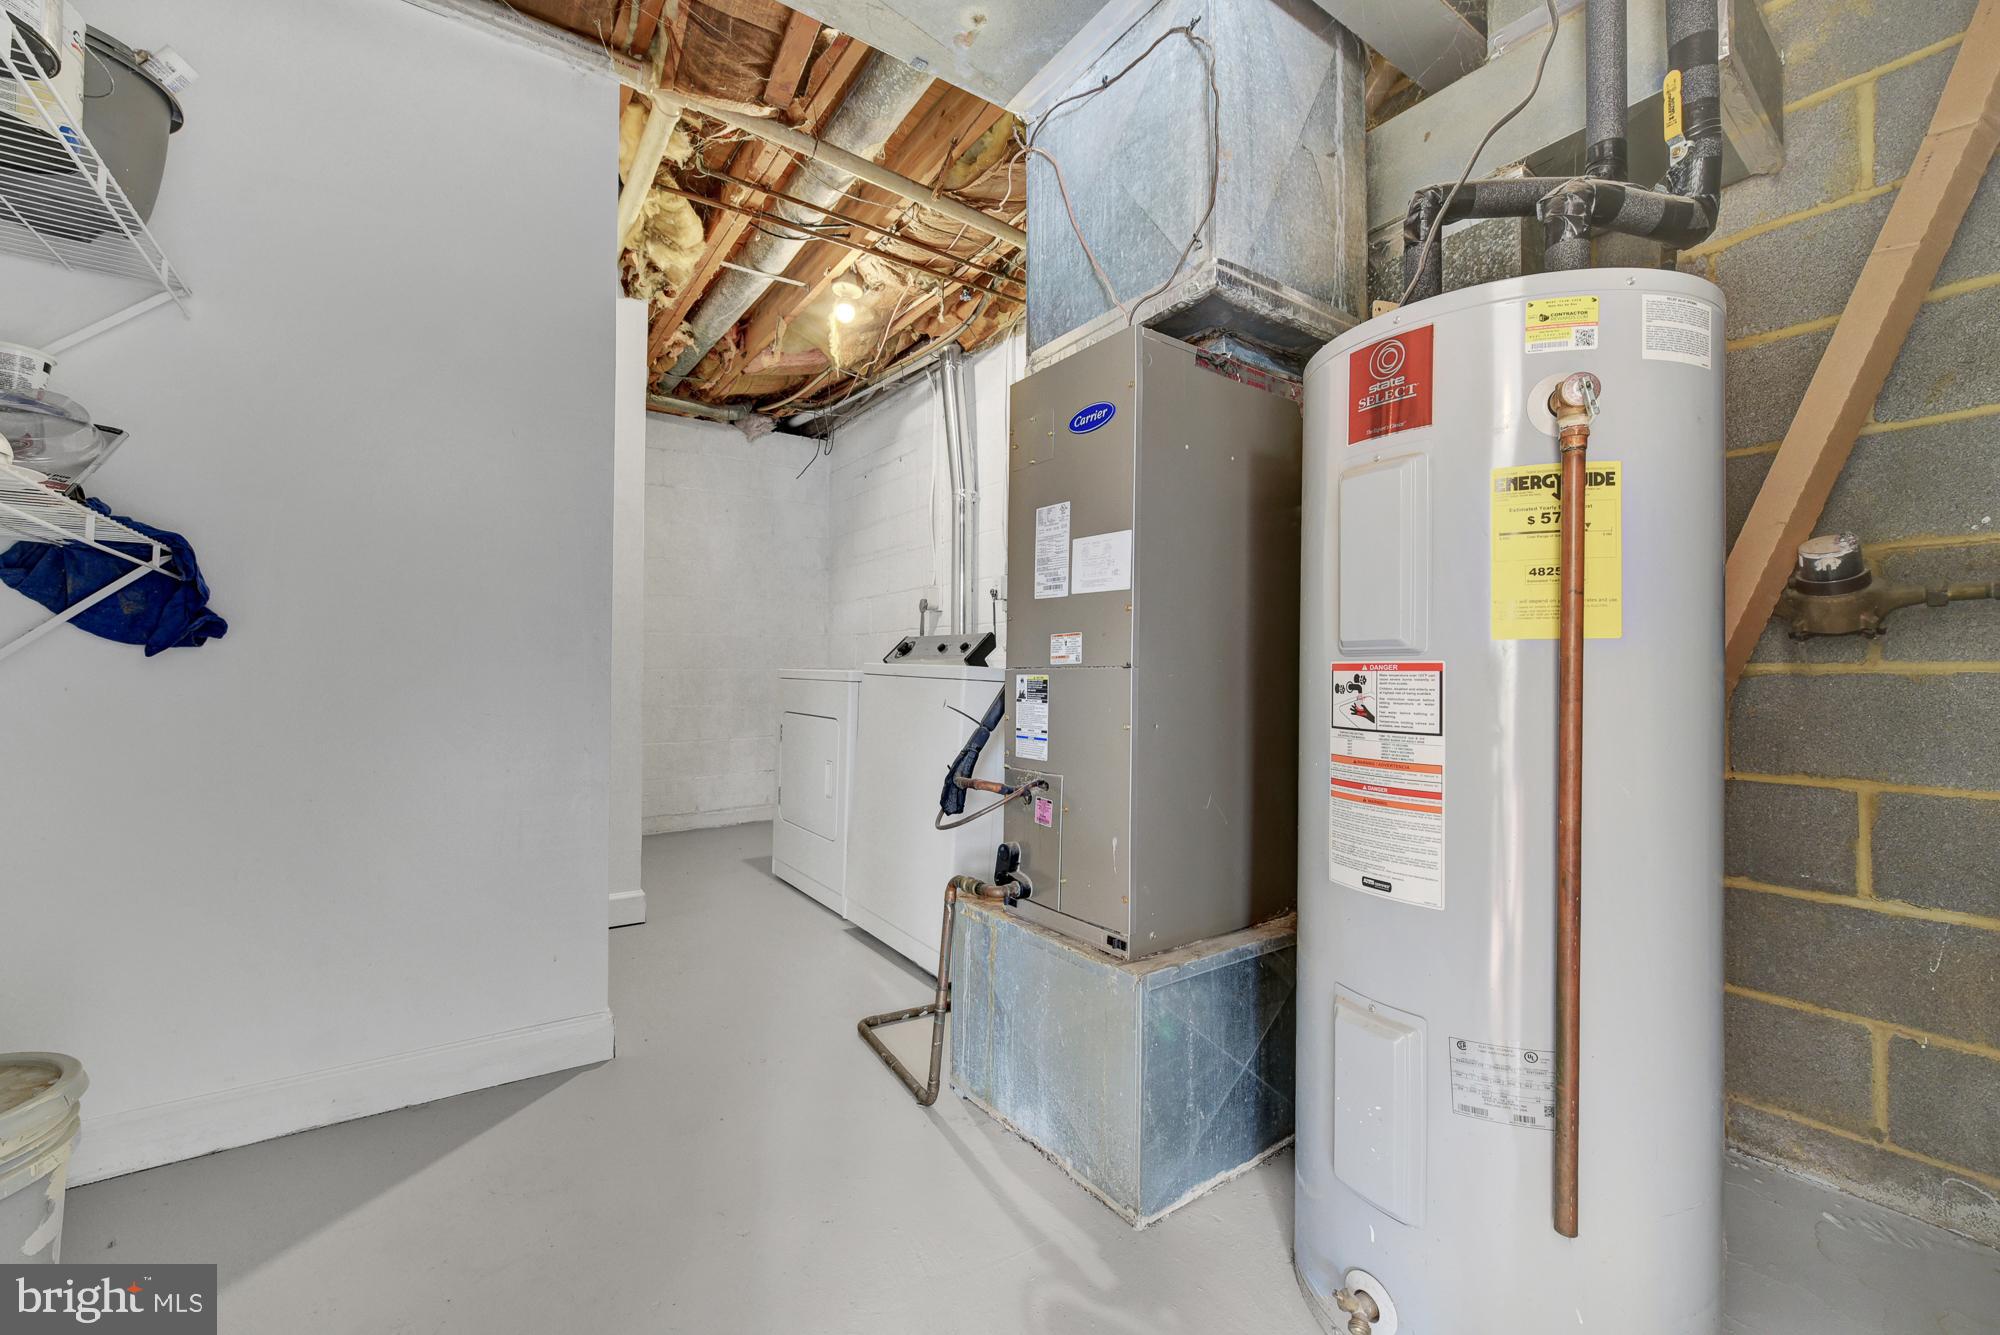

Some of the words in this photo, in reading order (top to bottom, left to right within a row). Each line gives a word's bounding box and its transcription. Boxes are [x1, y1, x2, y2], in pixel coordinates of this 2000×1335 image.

[1368, 376, 1406, 393] state
[1358, 383, 1417, 409] SELECT
[1074, 408, 1108, 428] Carrier
[1367, 785, 1388, 793] DANGER
